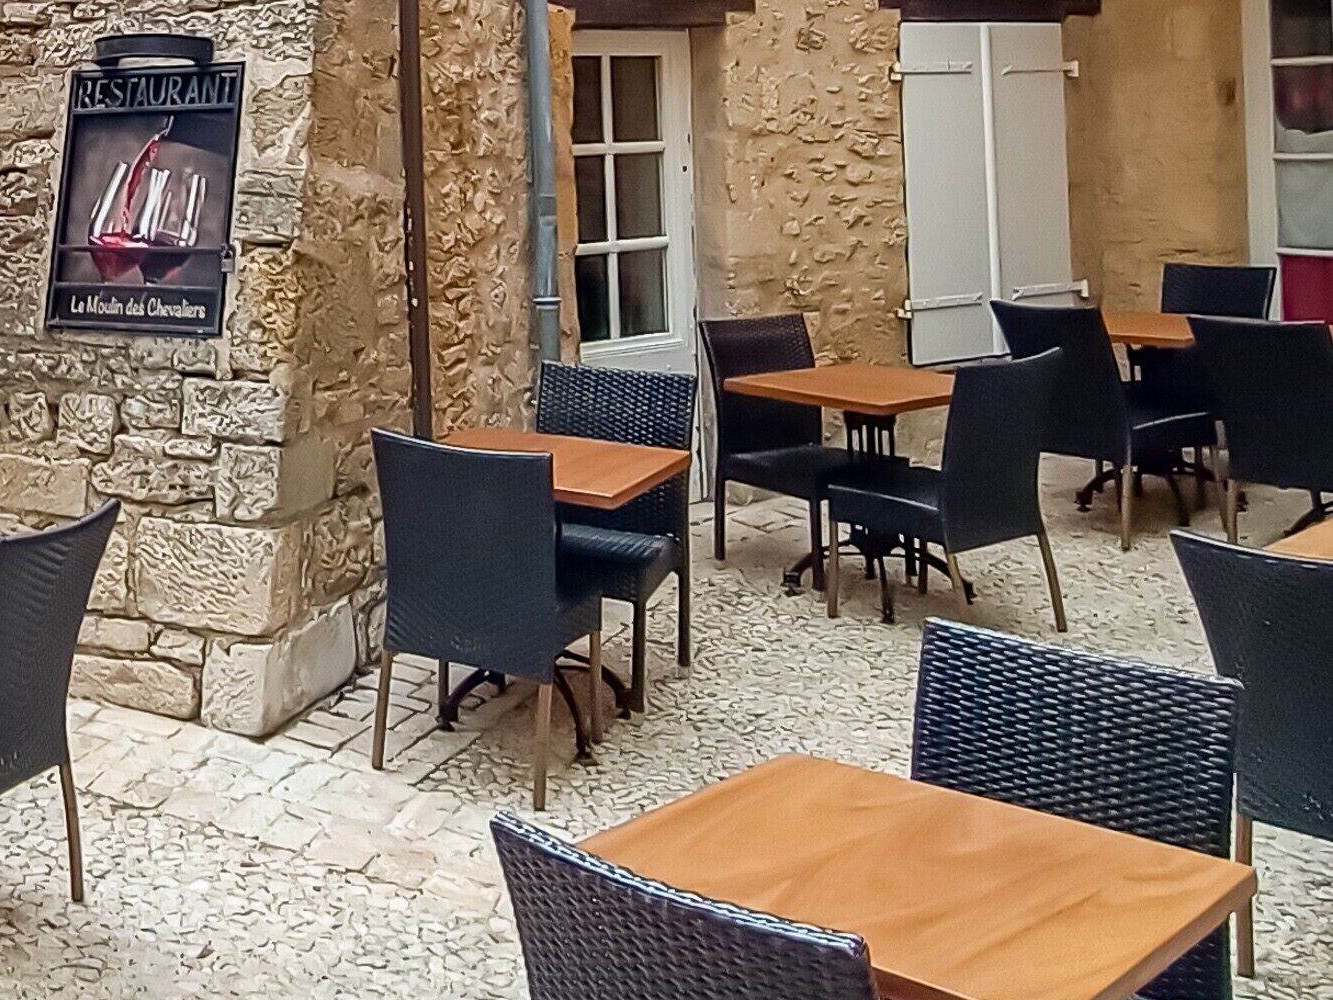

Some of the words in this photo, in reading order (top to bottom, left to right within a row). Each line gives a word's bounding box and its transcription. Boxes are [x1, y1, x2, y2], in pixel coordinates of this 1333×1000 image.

[77, 71, 237, 110] RESTAURANT
[71, 295, 84, 314] Le
[86, 295, 123, 315] Moulin
[125, 297, 144, 317] des
[147, 297, 206, 319] Chevaliers
